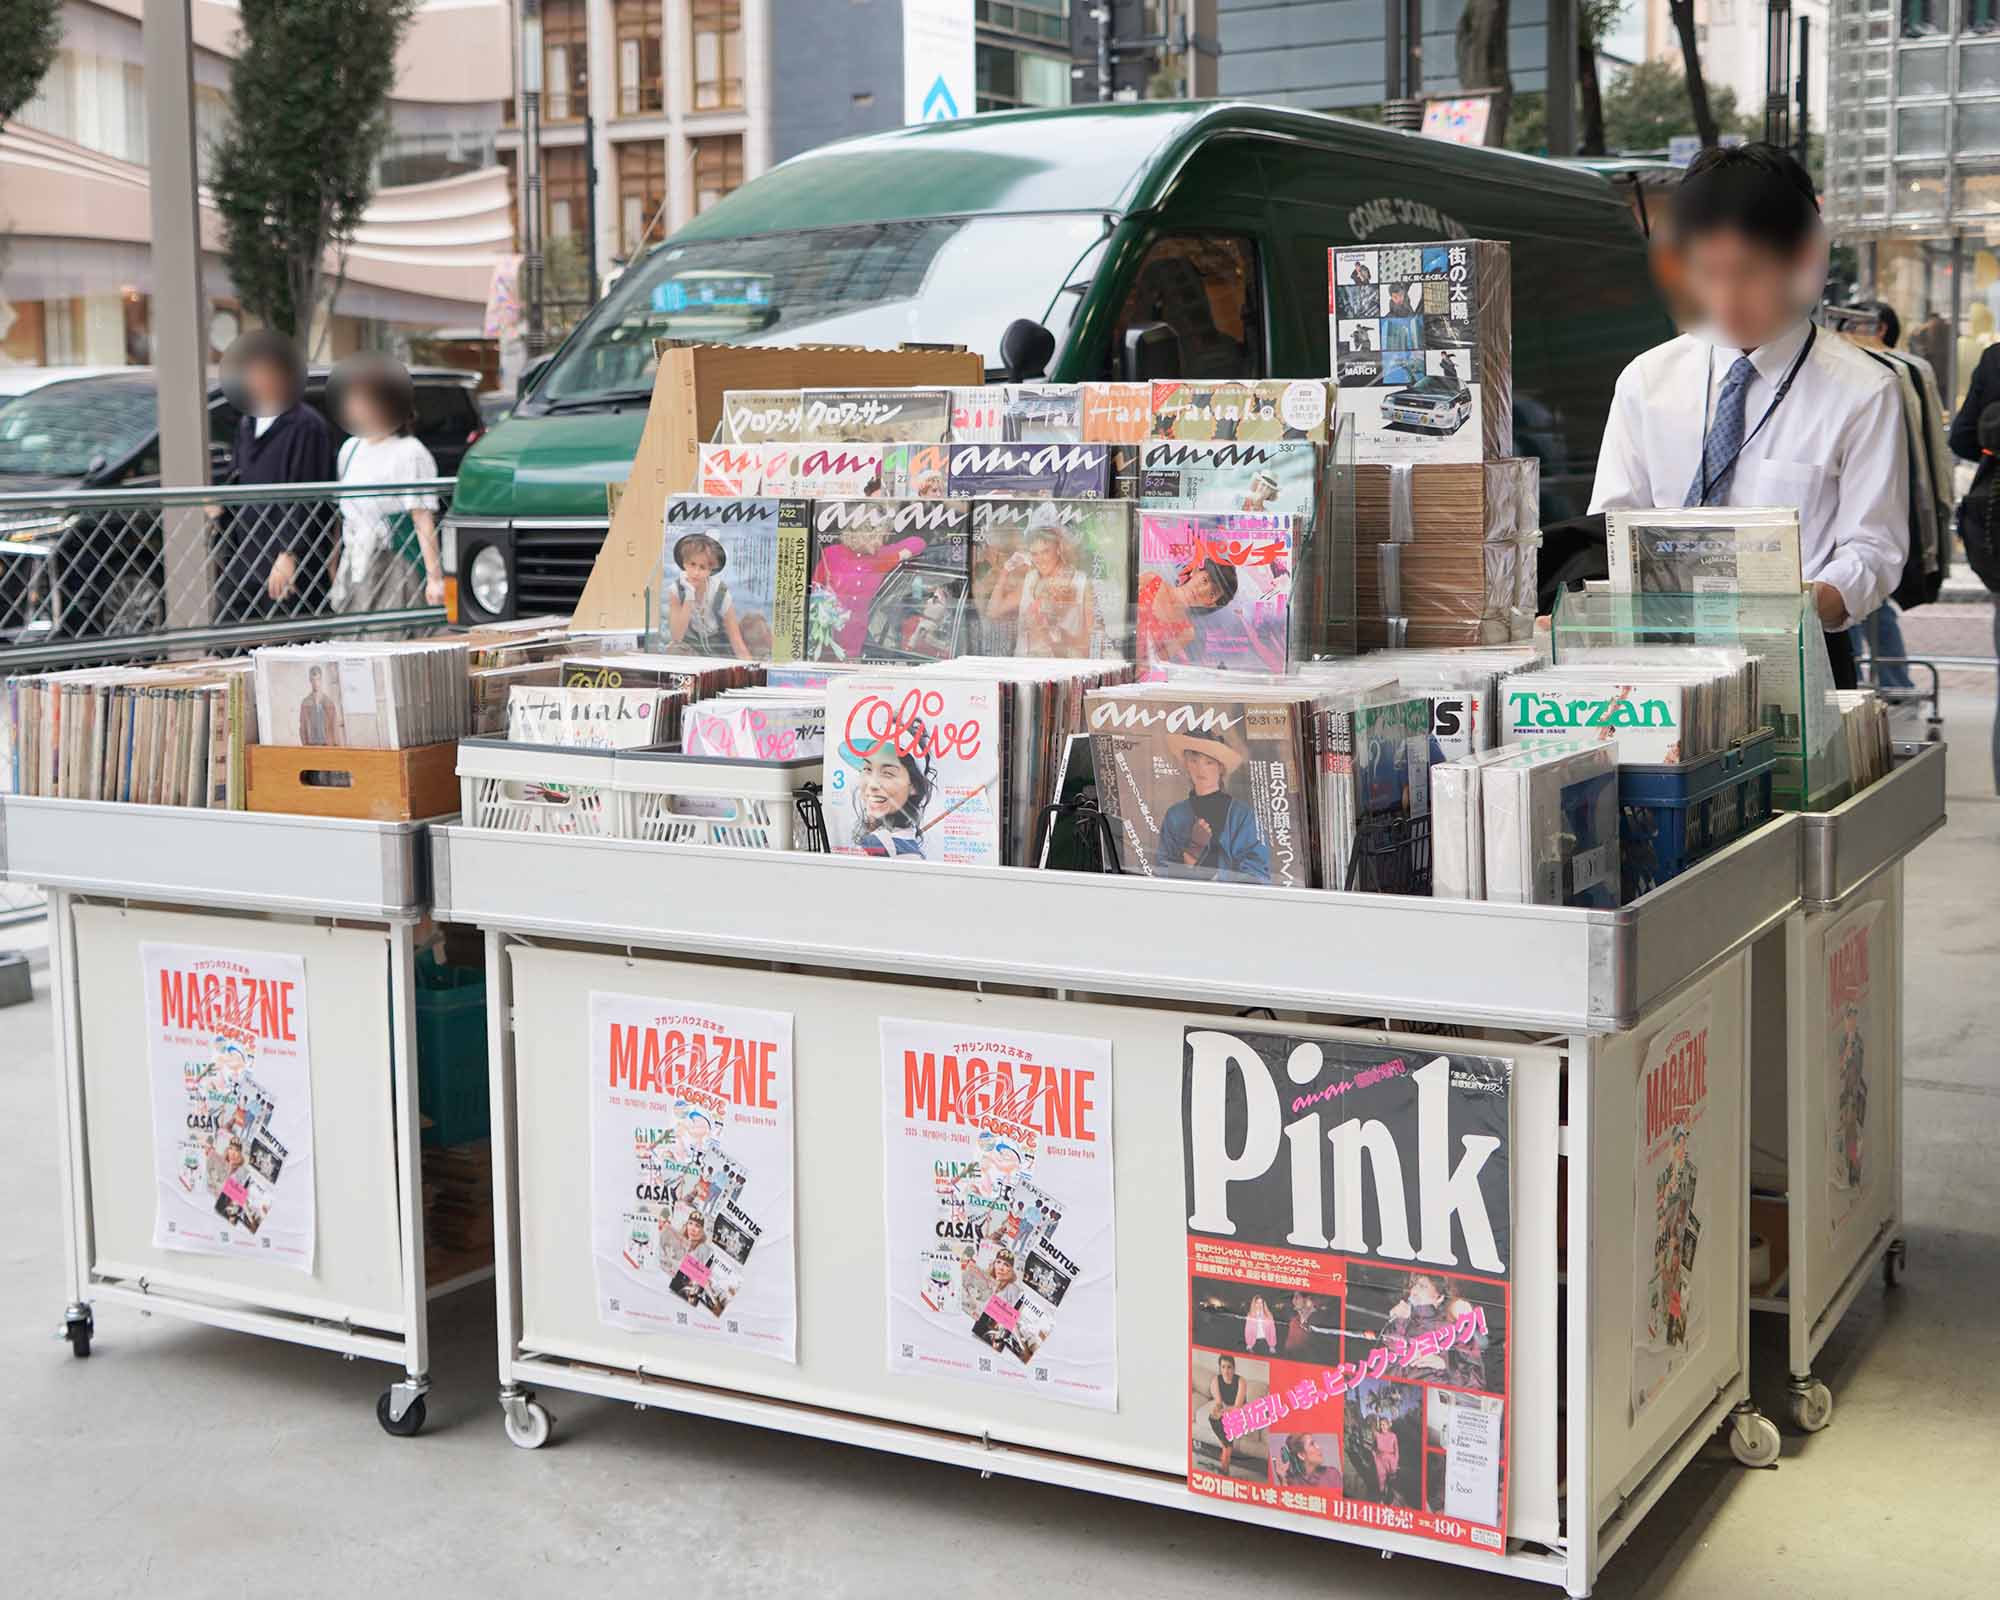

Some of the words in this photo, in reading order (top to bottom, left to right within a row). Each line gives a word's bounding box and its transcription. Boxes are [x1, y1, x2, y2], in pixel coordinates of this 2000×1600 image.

[1349, 198, 1397, 240] COME
[1448, 247, 1470, 325] 街の太陽。
[1344, 367, 1377, 376] MARCH
[805, 399, 904, 434] クロワッサン
[1146, 443, 1280, 468] an·an
[667, 500, 778, 524] an·an
[845, 688, 982, 761] Olive
[1092, 701, 1244, 733] an·an
[1509, 693, 1677, 727] Tarzan
[831, 769, 846, 790] 3
[1186, 1030, 1506, 1274] Pink
[636, 1184, 670, 1200] CASA
[726, 1200, 763, 1237] BRUTUS
[936, 1221, 974, 1239] CASA
[1039, 1236, 1081, 1276] BRUTUS
